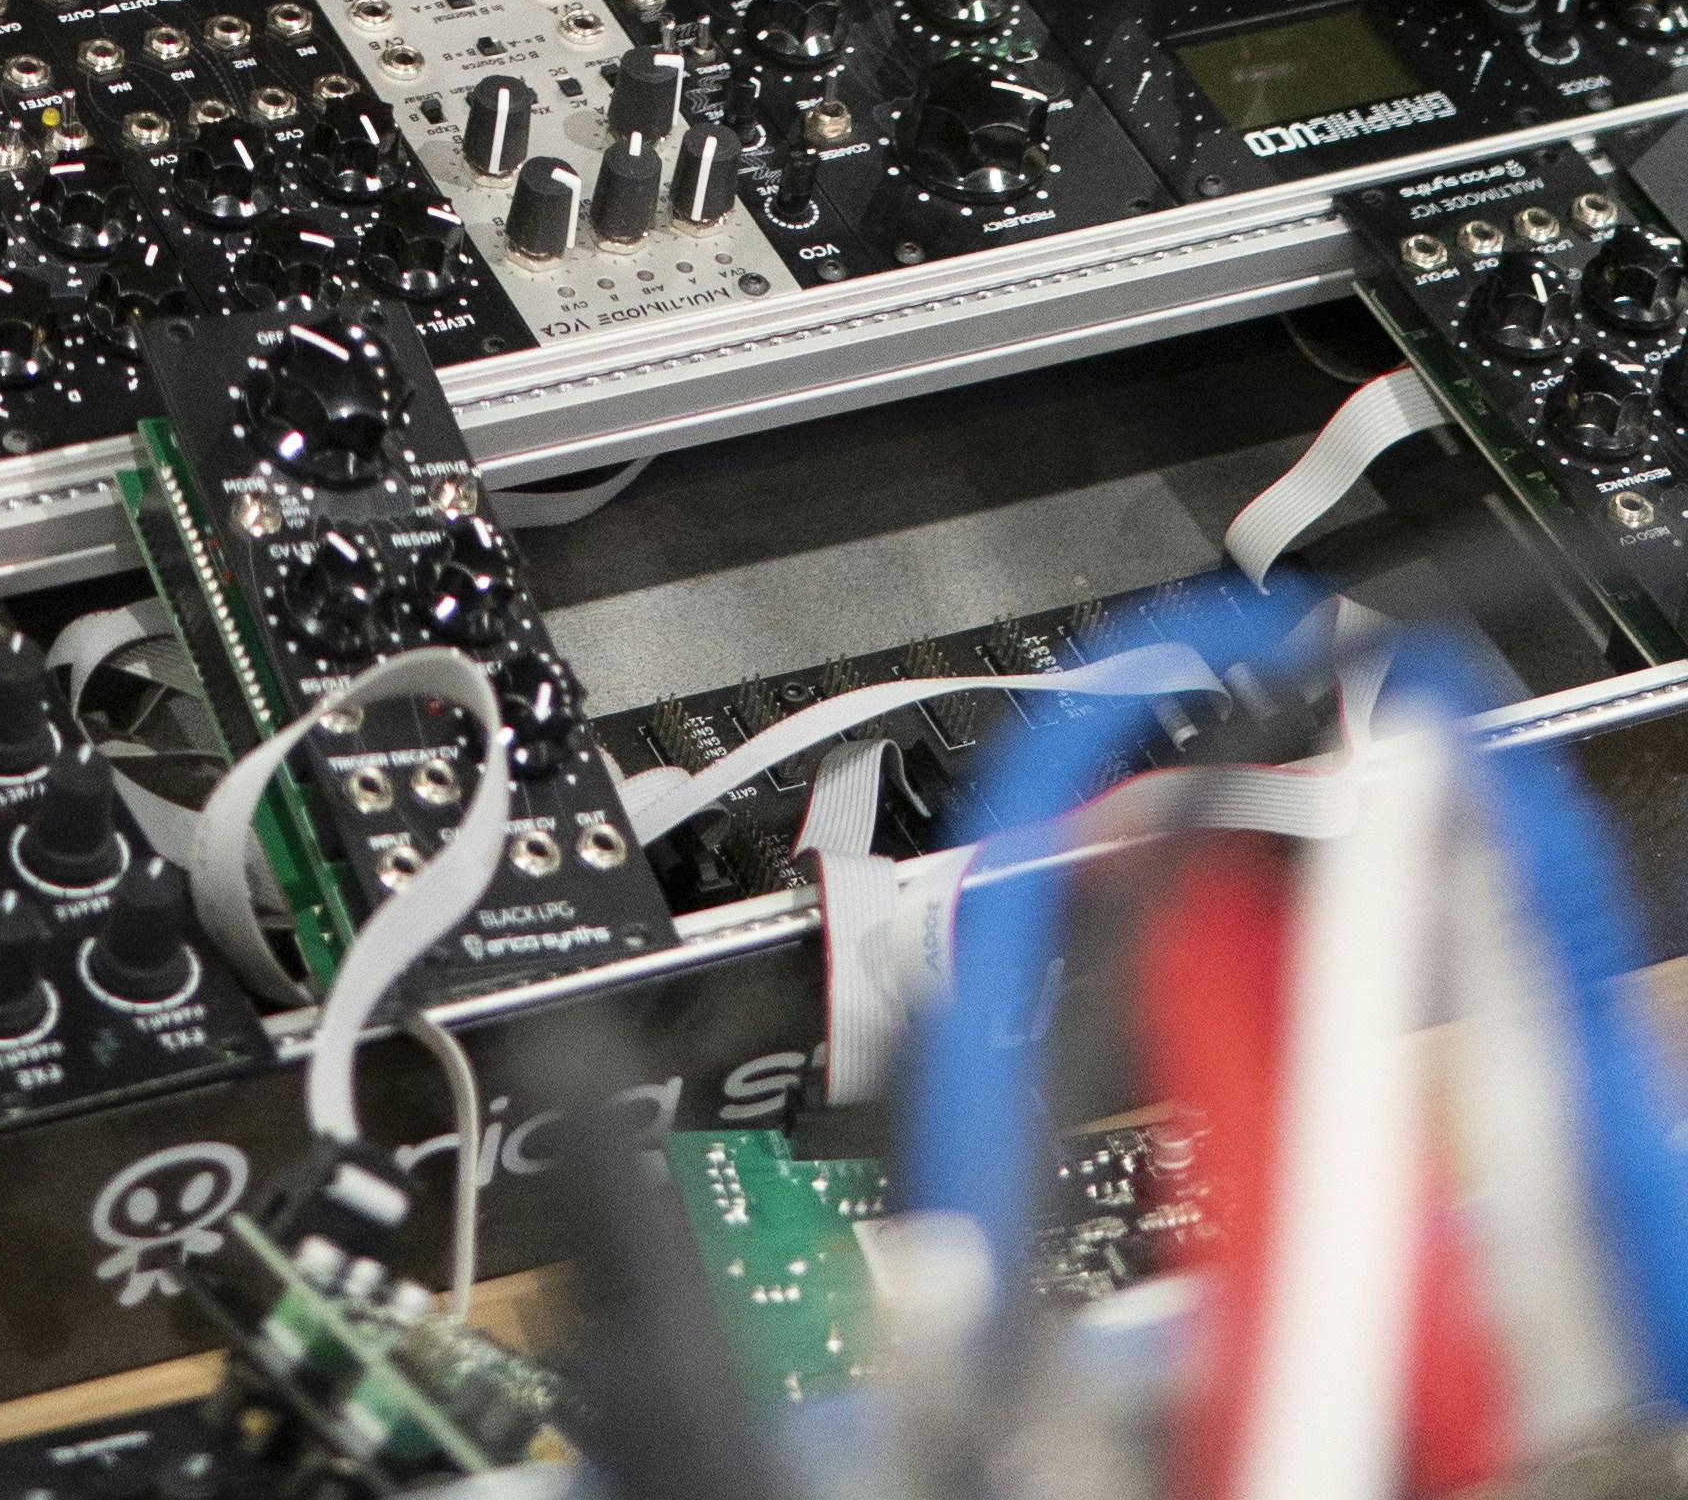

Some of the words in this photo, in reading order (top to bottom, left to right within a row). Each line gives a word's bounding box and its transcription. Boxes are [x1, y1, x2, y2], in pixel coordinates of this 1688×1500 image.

[461, 58, 506, 71] Source
[549, 66, 568, 76] DC
[403, 91, 443, 104] Linear
[571, 99, 588, 109] AC
[275, 128, 304, 141] CV2
[427, 124, 460, 136] Expo
[799, 243, 840, 260] VCO
[642, 284, 664, 295] A+B
[597, 287, 730, 326] MULTIMODE
[427, 314, 475, 332] LEVEL
[540, 318, 591, 338] VCA
[257, 330, 284, 346] OFF
[222, 478, 267, 494] MODE
[328, 753, 388, 771] TRIGGER
[391, 747, 437, 765] DECAY
[437, 745, 458, 759] CV
[534, 816, 555, 830] CV
[575, 809, 606, 826] OUT
[367, 831, 411, 850] INPUT
[479, 905, 533, 929] BLACK
[534, 900, 574, 919] LPG
[486, 933, 539, 955] erica
[540, 924, 611, 951] synths
